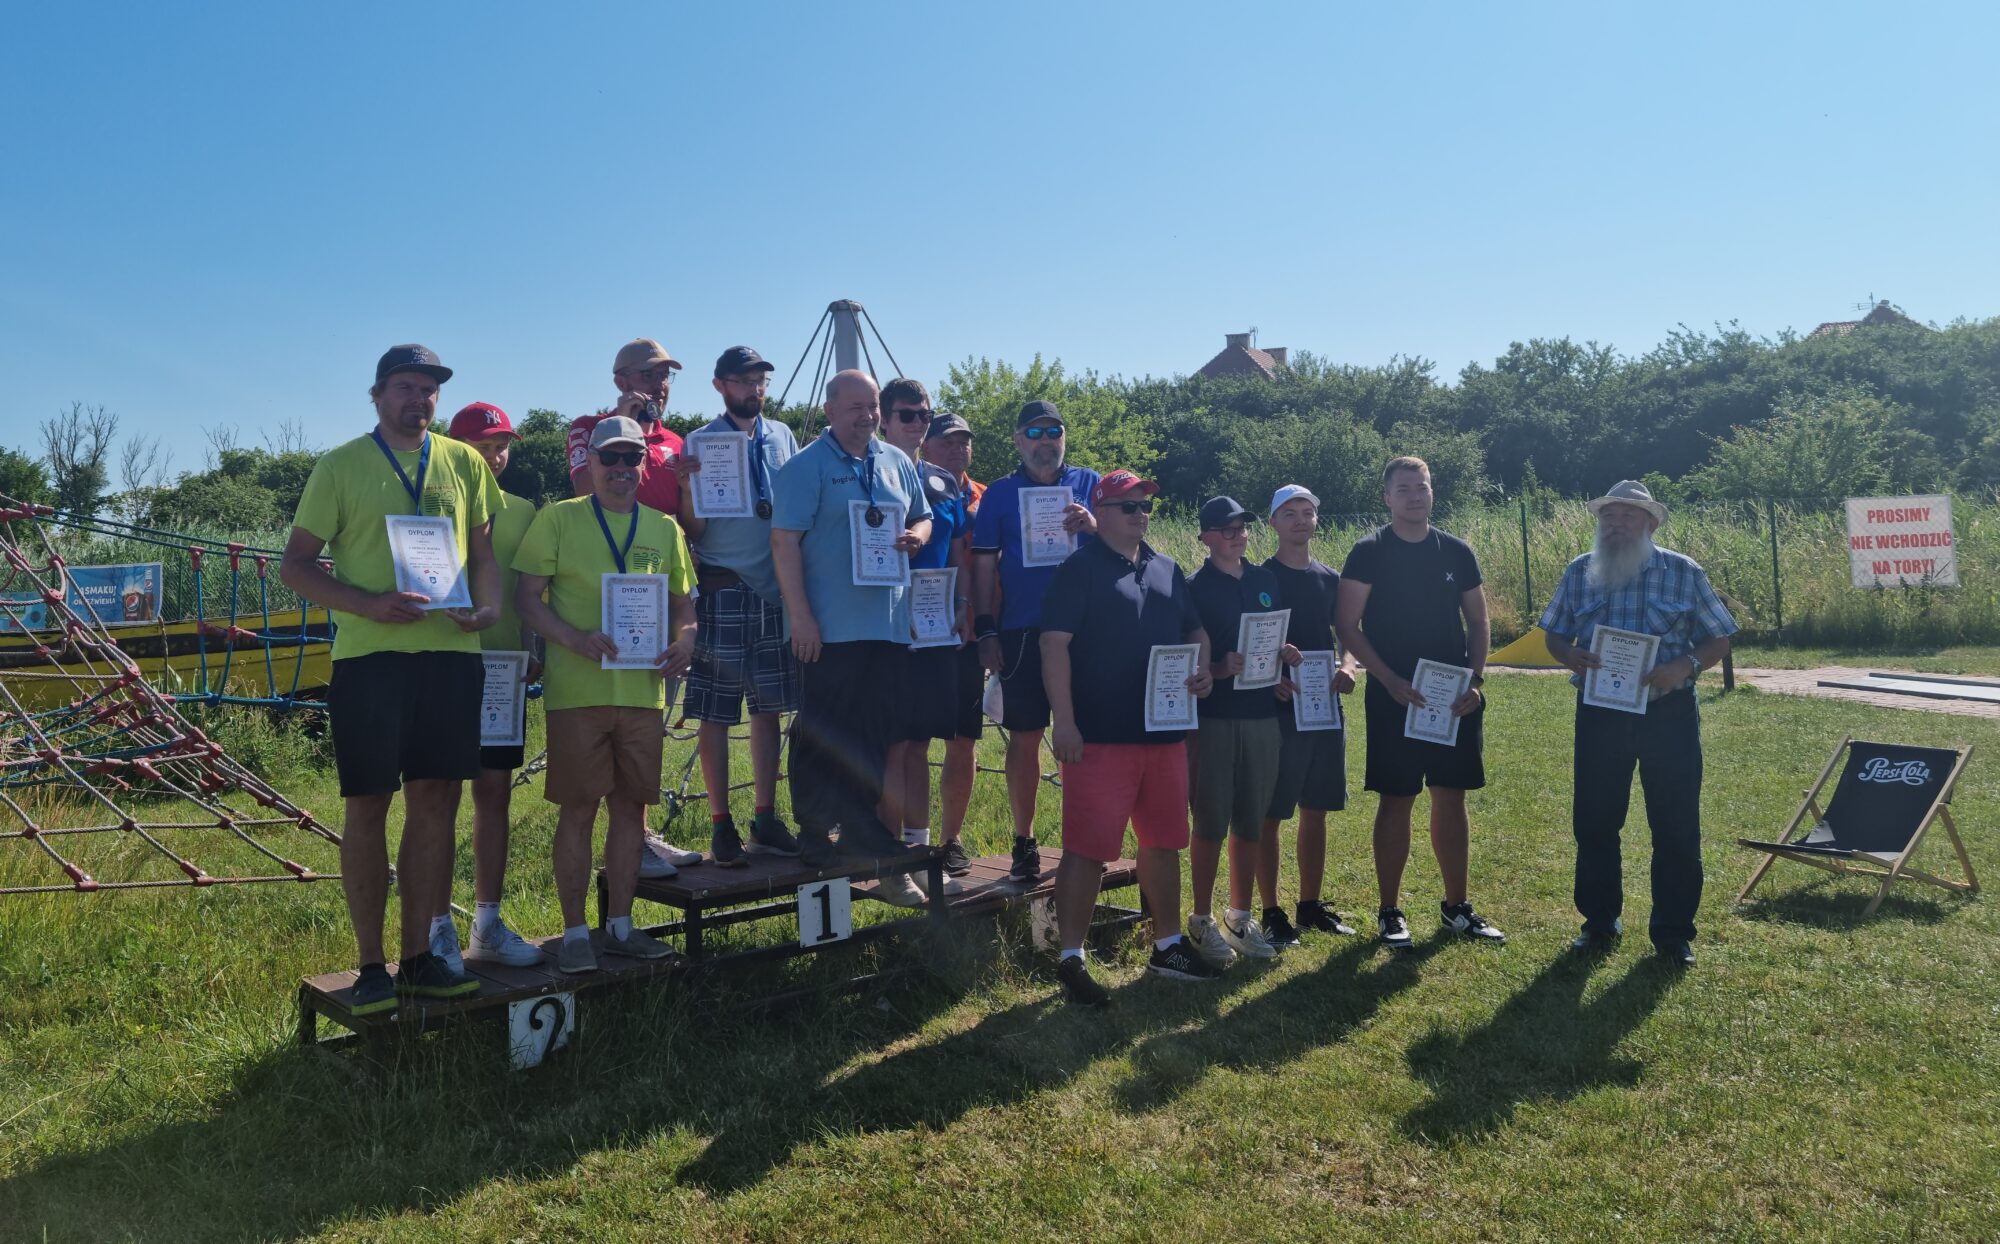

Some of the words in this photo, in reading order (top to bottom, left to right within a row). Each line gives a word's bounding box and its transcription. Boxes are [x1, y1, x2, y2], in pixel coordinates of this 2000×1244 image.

[1867, 507, 1930, 523] PROSIMY
[1851, 535, 1873, 550] NIE
[1875, 530, 1952, 549] WCHODZIĆ
[1872, 560, 1891, 575] NA
[74, 585, 117, 597] ASMAKUJ
[1611, 636, 1639, 646] DYPLOM
[1431, 671, 1455, 680] DYPLOM
[812, 884, 838, 942] 1
